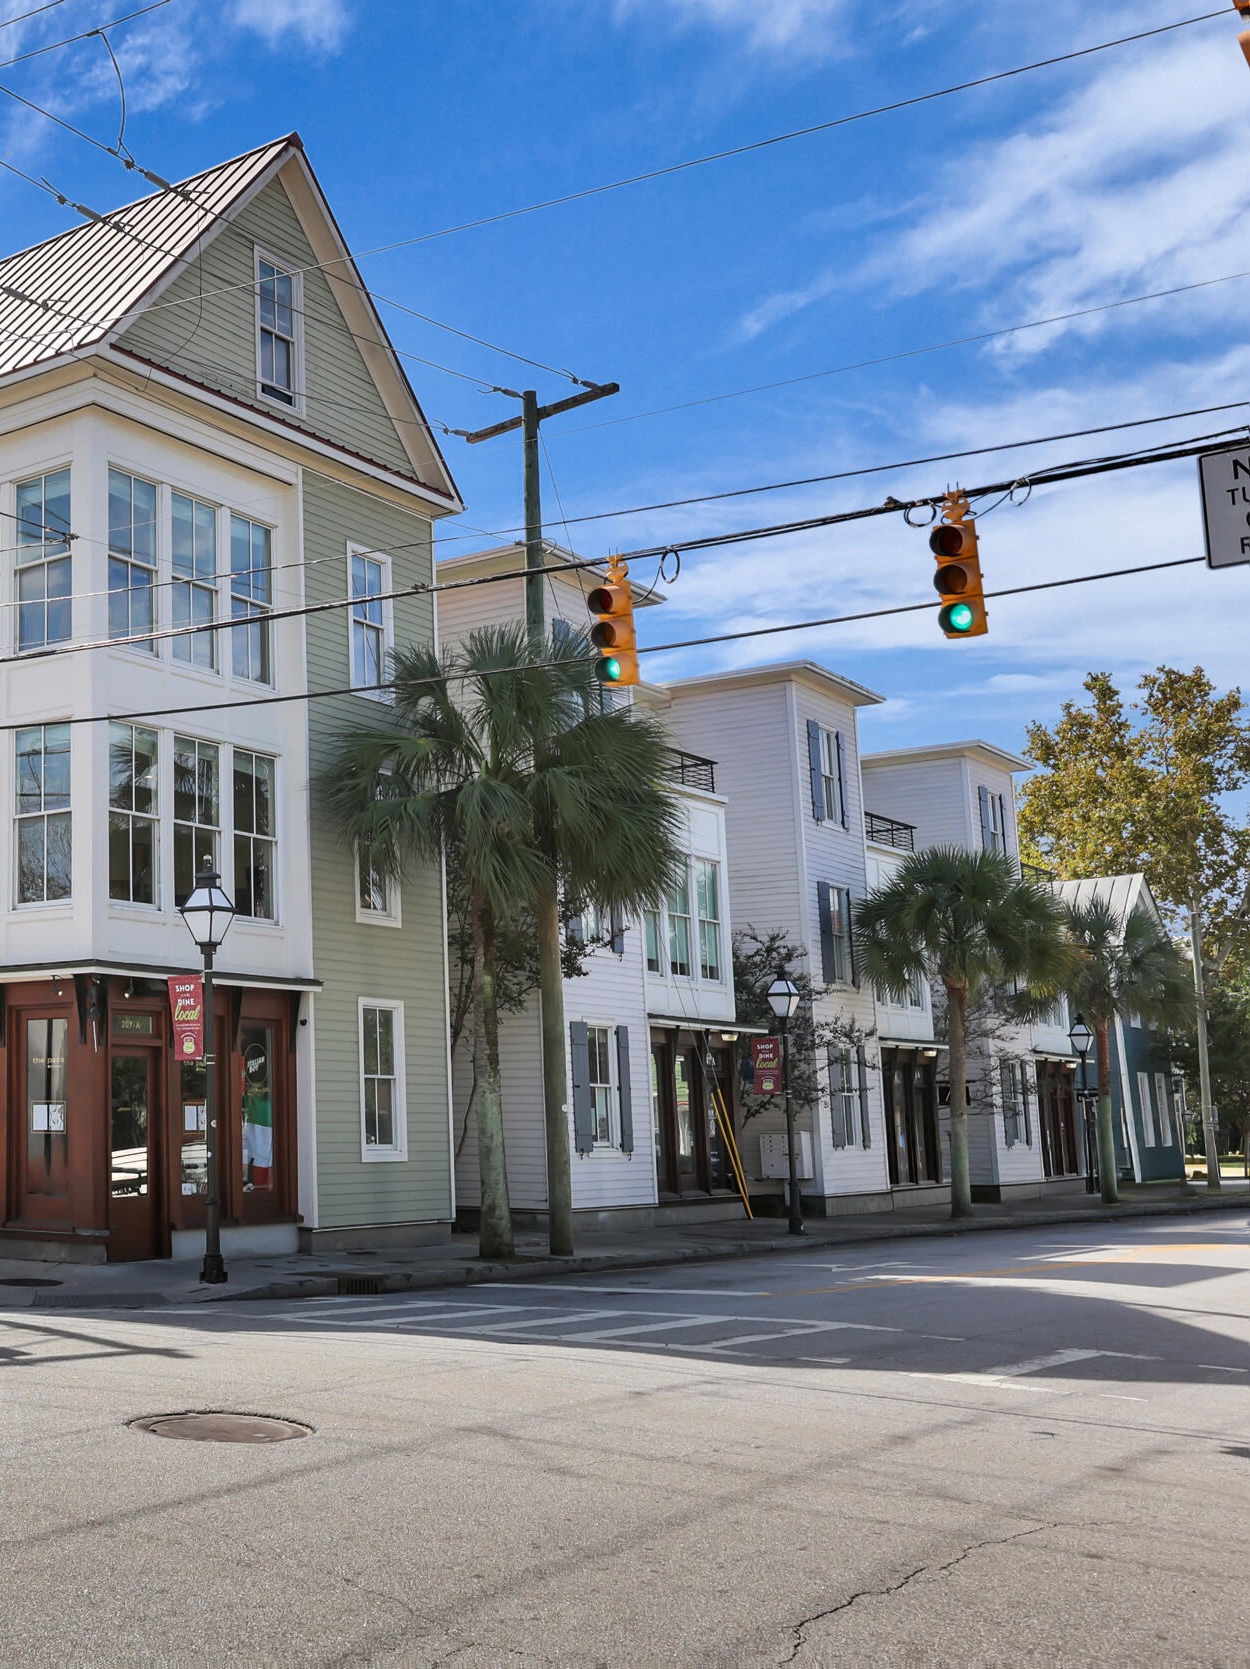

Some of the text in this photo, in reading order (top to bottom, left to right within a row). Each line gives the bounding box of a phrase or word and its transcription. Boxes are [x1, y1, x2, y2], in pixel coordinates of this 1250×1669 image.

[1232, 456, 1250, 480] N
[1226, 487, 1250, 506] TU
[175, 984, 195, 992] SHOP
[177, 998, 195, 1006] DINE
[174, 1004, 201, 1021] local
[756, 1057, 778, 1068] local
